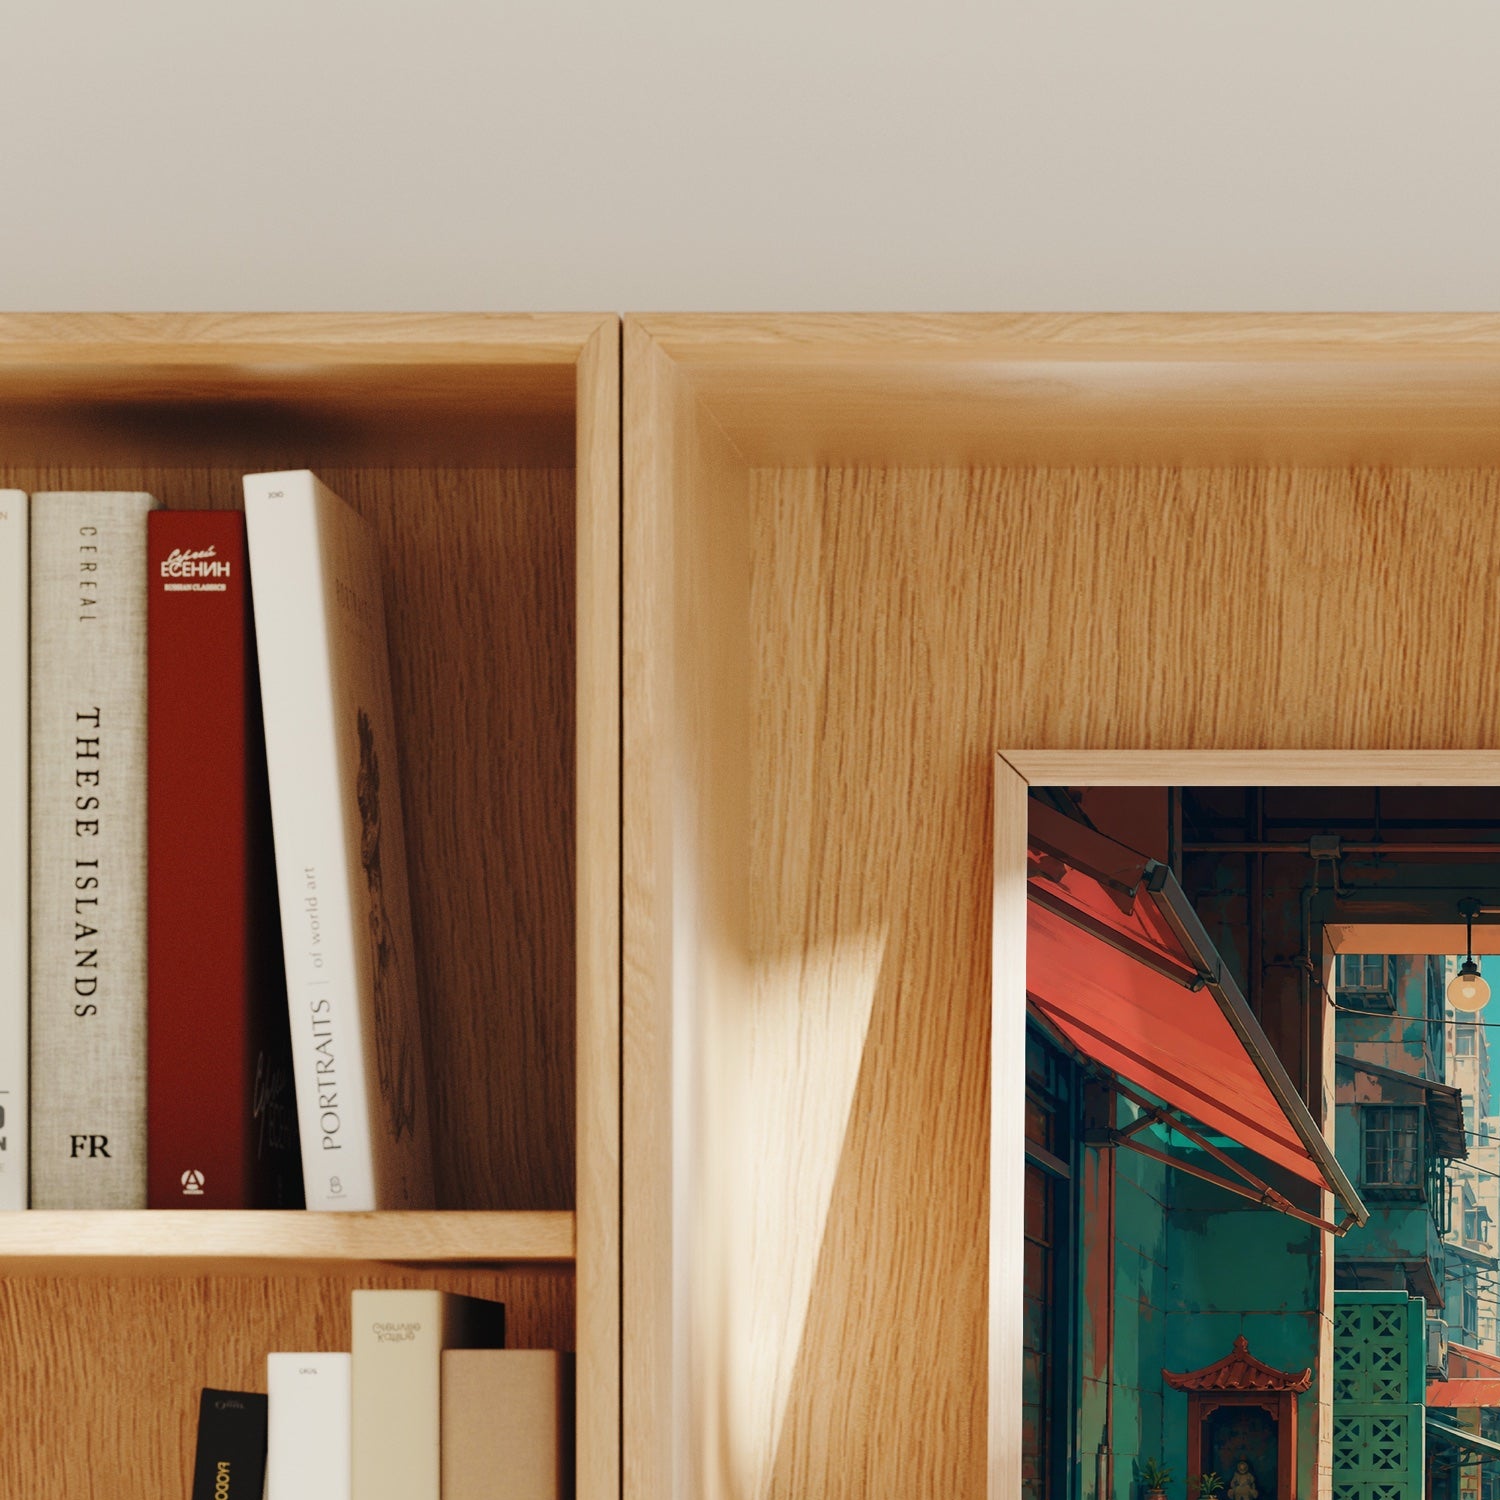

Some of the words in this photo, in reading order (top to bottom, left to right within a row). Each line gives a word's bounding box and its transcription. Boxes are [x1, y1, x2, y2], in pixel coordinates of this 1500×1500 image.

[80, 526, 97, 622] CEREAL
[160, 561, 231, 577] ЕСЕНИН
[76, 706, 101, 838] THESE
[304, 866, 316, 892] art
[75, 859, 99, 1018] ISLANDS
[305, 896, 322, 945] world
[312, 952, 323, 968] of
[311, 999, 342, 1151] PORTRAITS
[69, 1134, 112, 1158] FR
